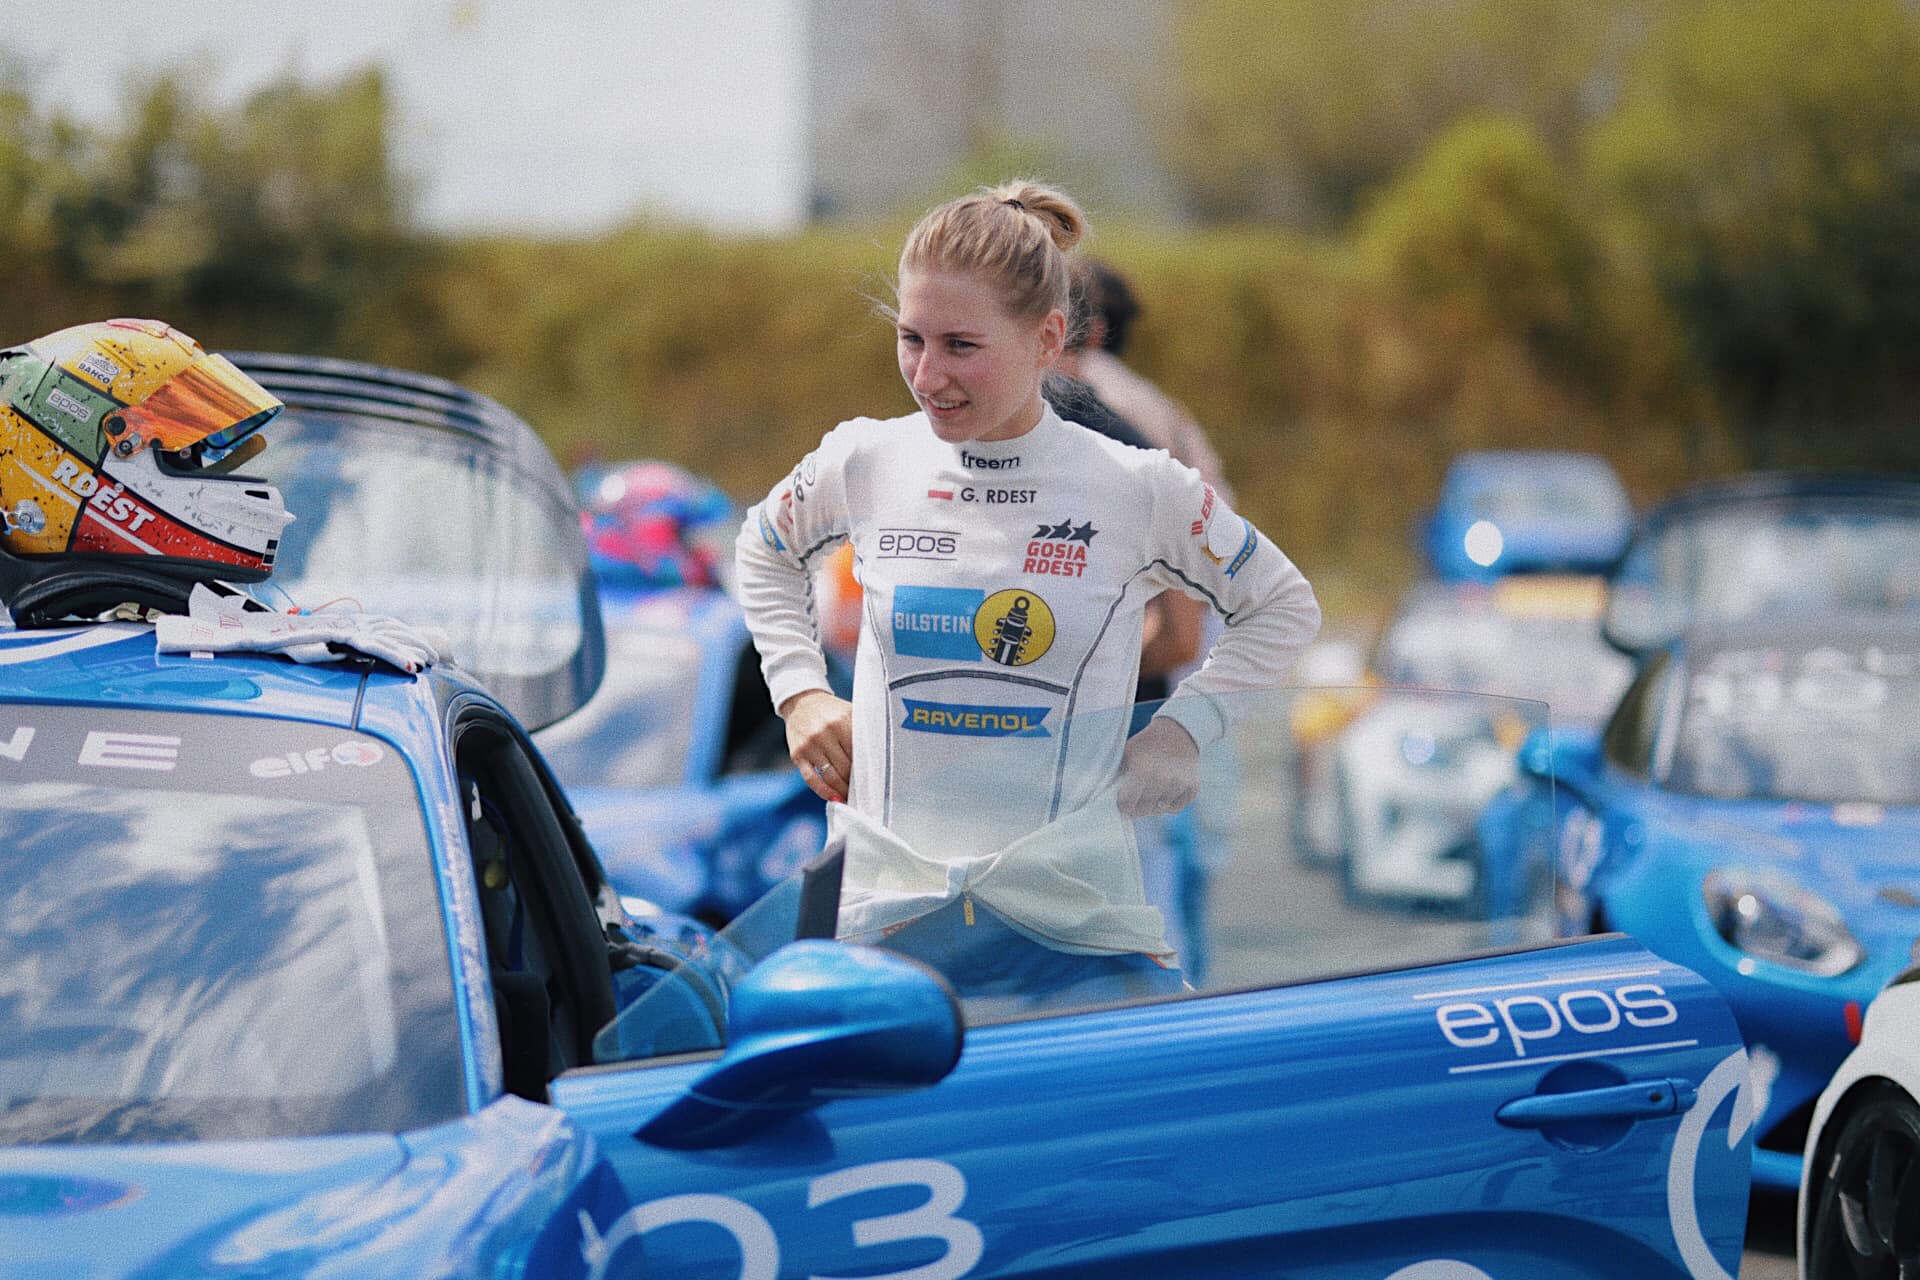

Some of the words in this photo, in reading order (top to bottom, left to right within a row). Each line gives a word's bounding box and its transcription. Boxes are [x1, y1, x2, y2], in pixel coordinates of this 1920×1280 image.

[50, 393, 89, 418] epos
[961, 451, 1020, 469] freem
[51, 458, 156, 532] RDEST
[960, 487, 979, 503] G.
[986, 489, 1037, 504] RDEST
[879, 534, 957, 556] epos
[1026, 541, 1087, 562] GOSIA
[1022, 558, 1088, 578] RDEST
[895, 612, 971, 634] BILSTEIN
[912, 708, 1037, 731] RAVENOL
[249, 747, 331, 778] elf
[1436, 984, 1678, 1057] epos
